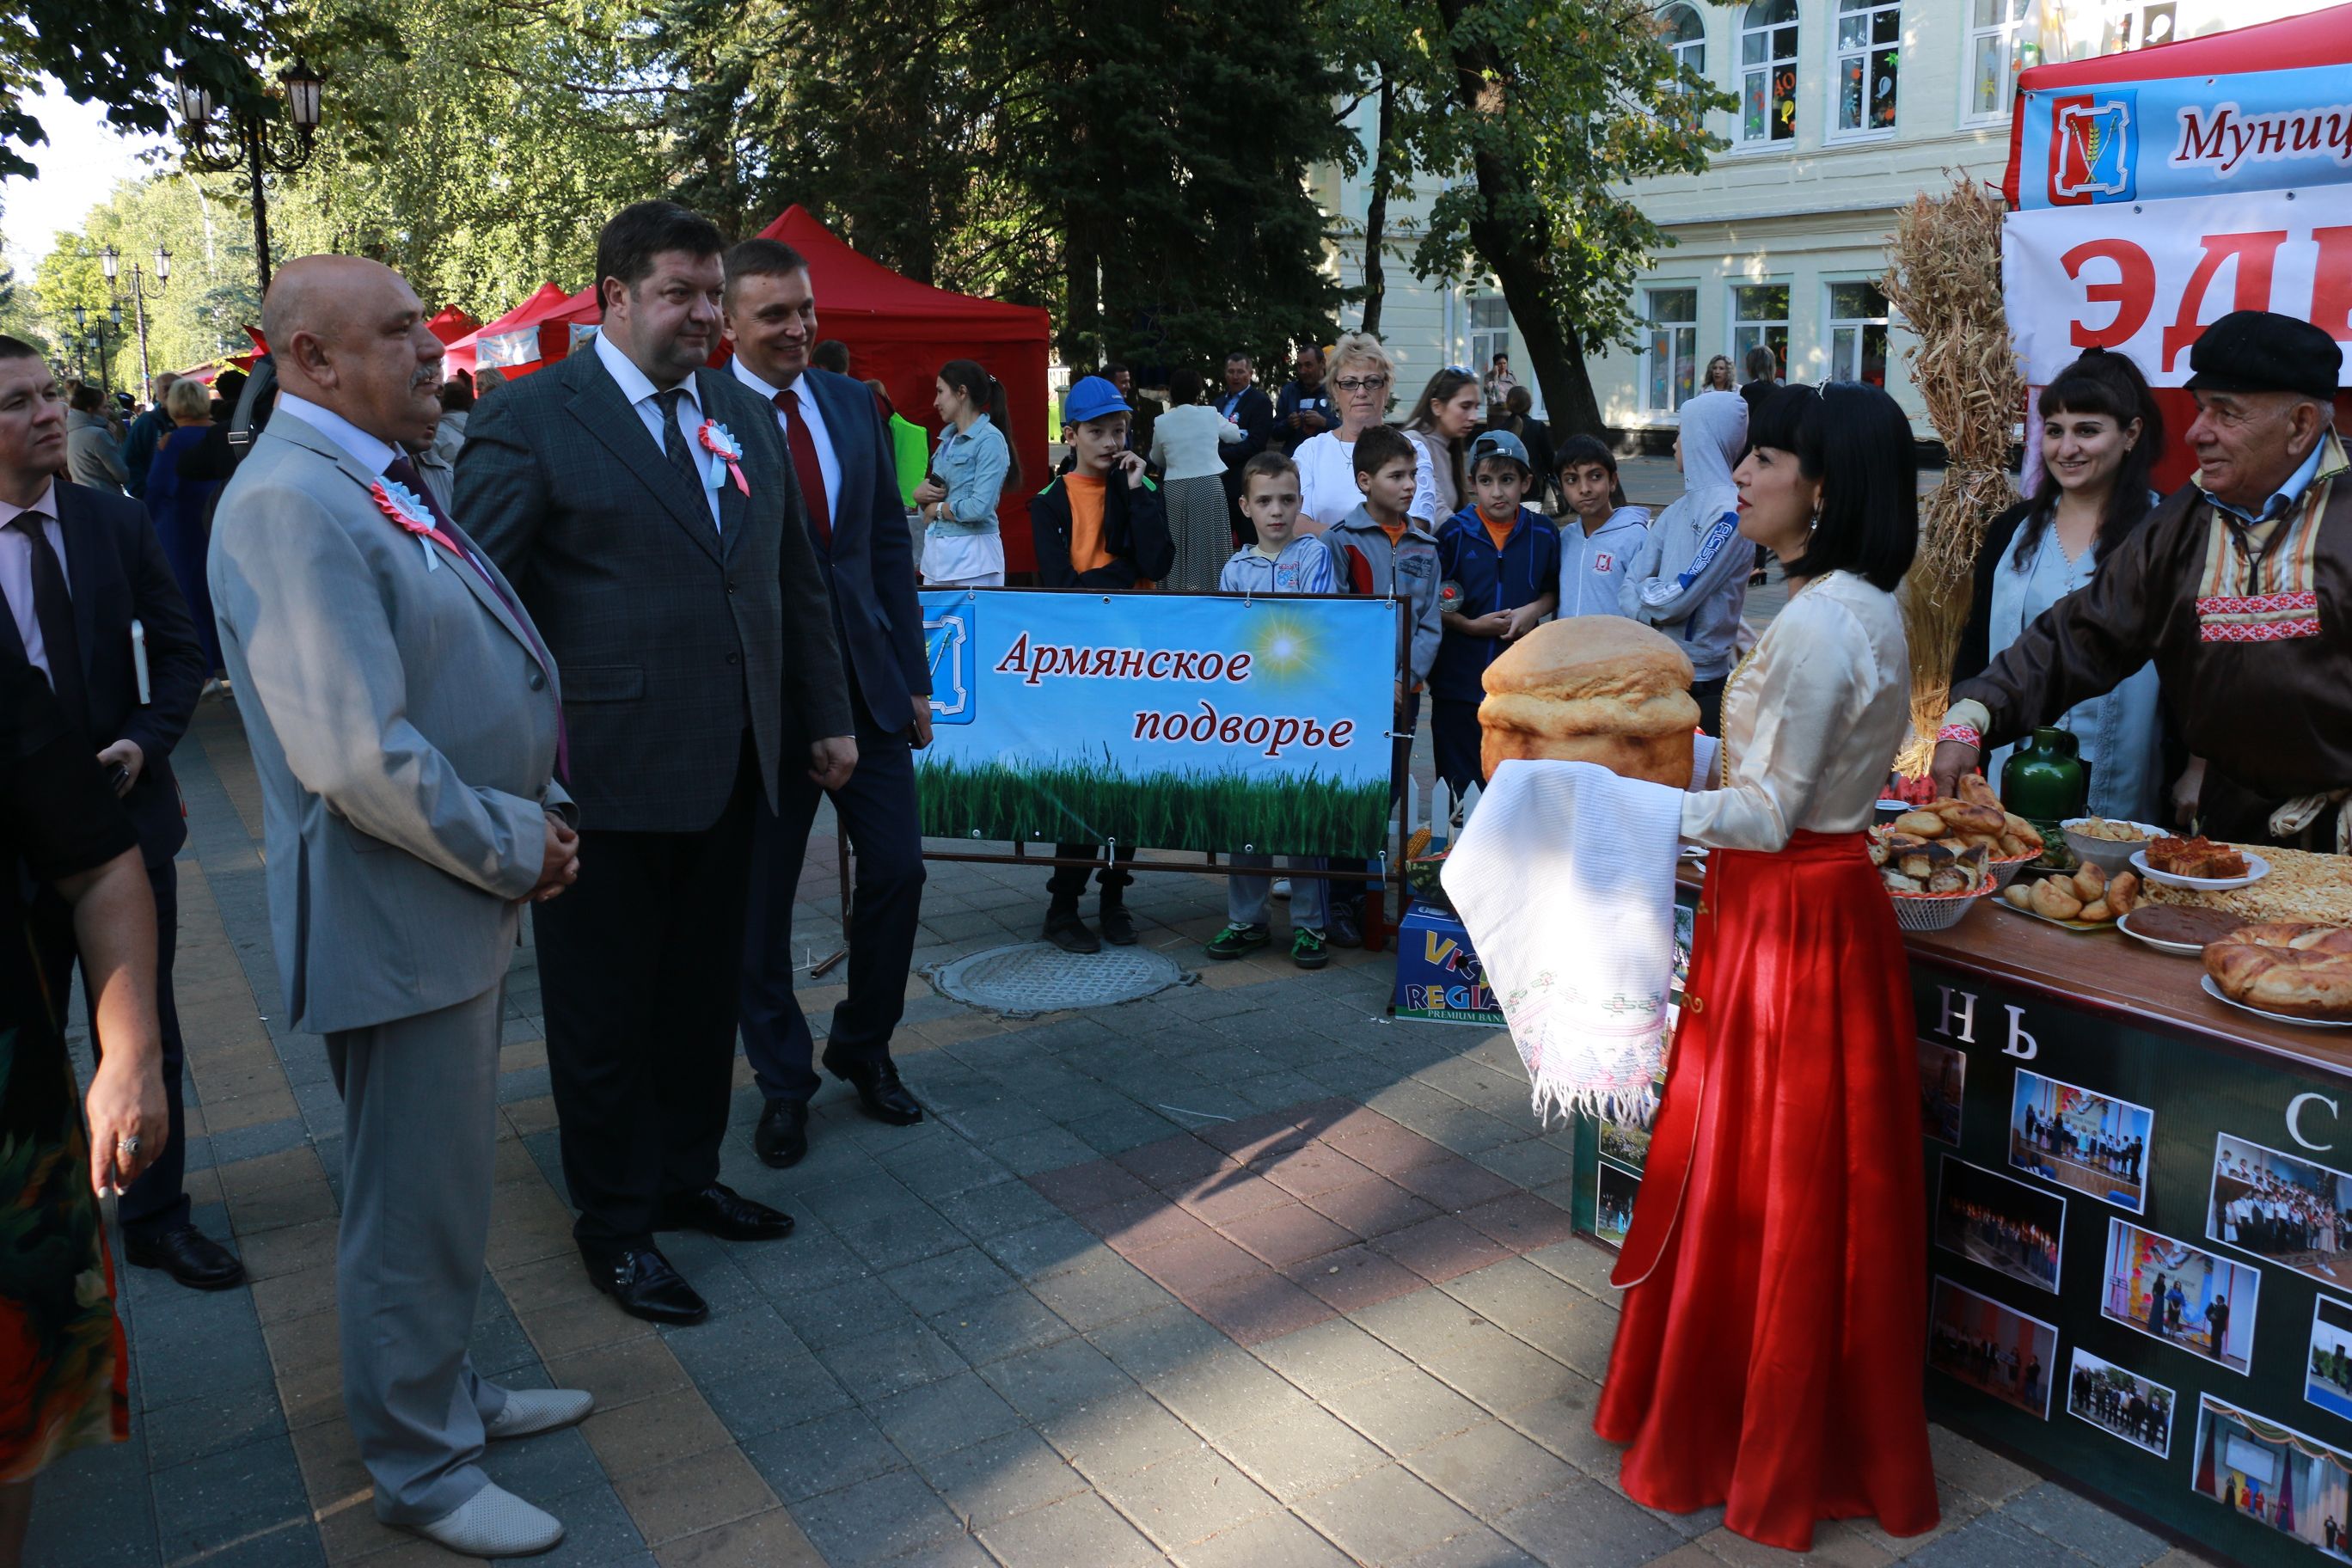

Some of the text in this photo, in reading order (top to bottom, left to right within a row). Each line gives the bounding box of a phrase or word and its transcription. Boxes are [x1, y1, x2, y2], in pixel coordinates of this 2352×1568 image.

[995, 633, 1252, 684] Армянское
[1136, 701, 1353, 756] подворье
[1427, 1009, 1476, 1020] PREMIUM
